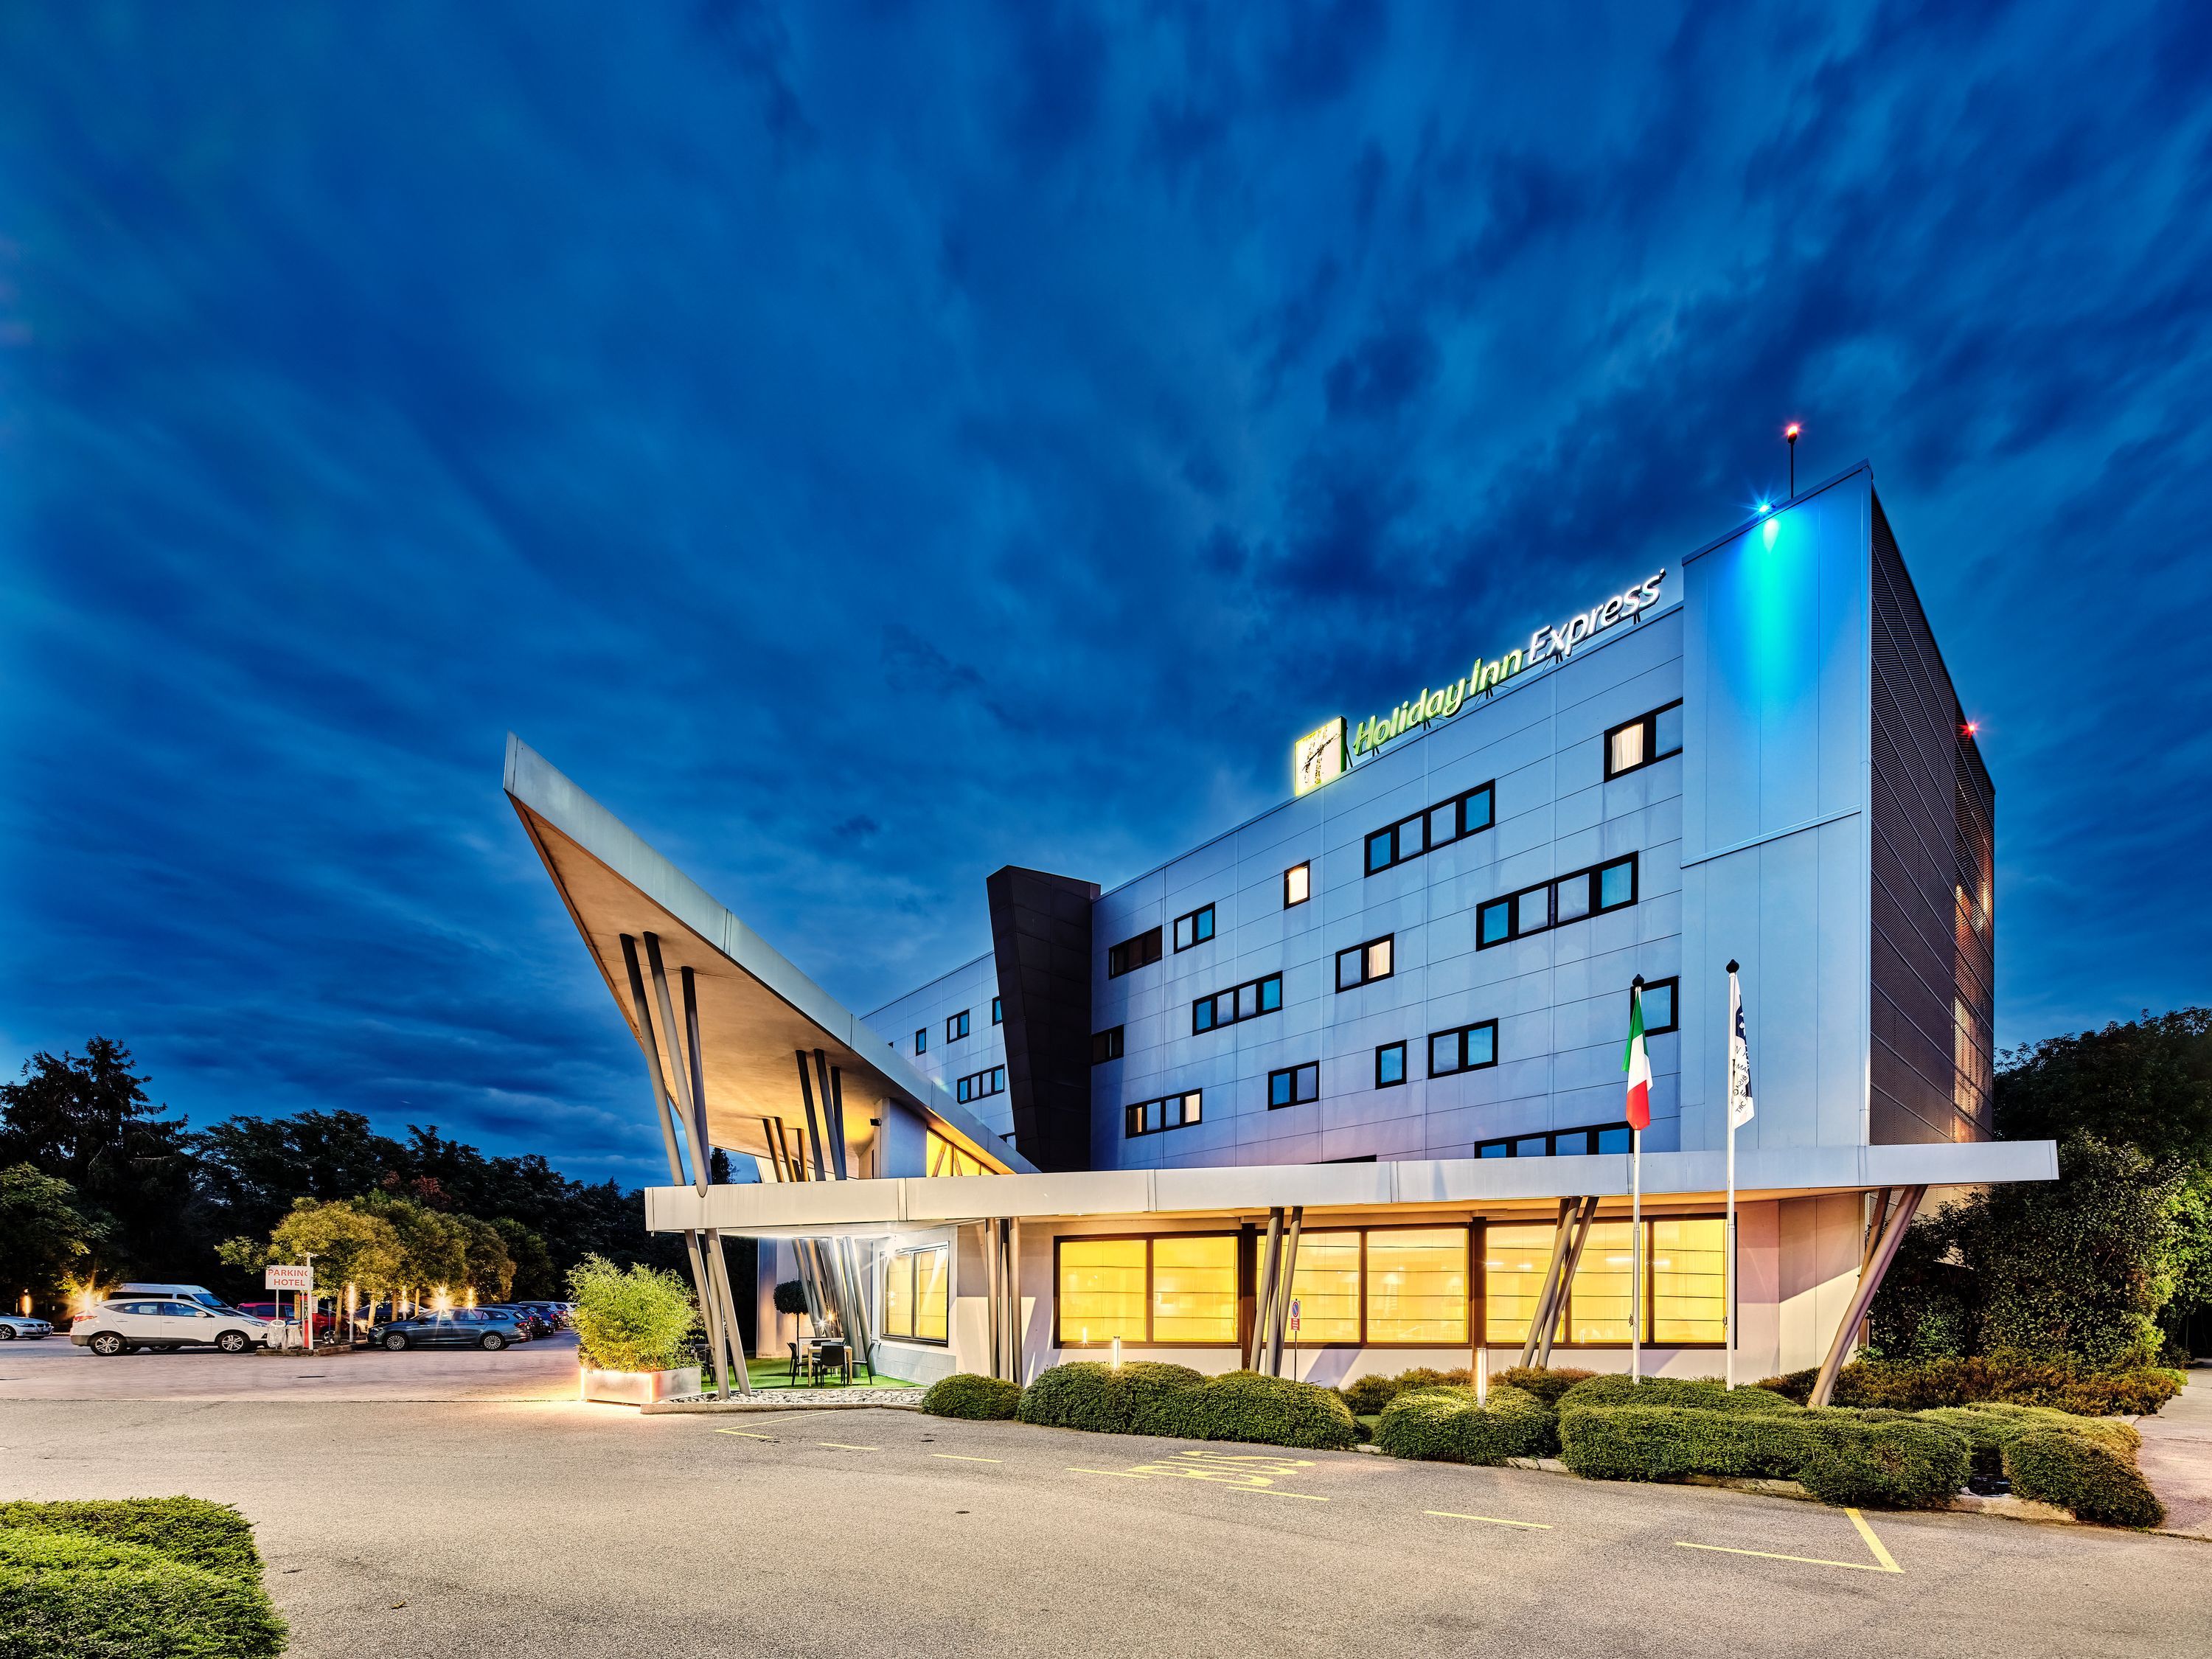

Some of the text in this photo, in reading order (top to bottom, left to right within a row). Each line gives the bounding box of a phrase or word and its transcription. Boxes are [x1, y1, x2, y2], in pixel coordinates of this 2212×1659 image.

[1353, 574, 1660, 756] Holiday Inn Express
[1126, 1450, 1317, 1486] BUS
